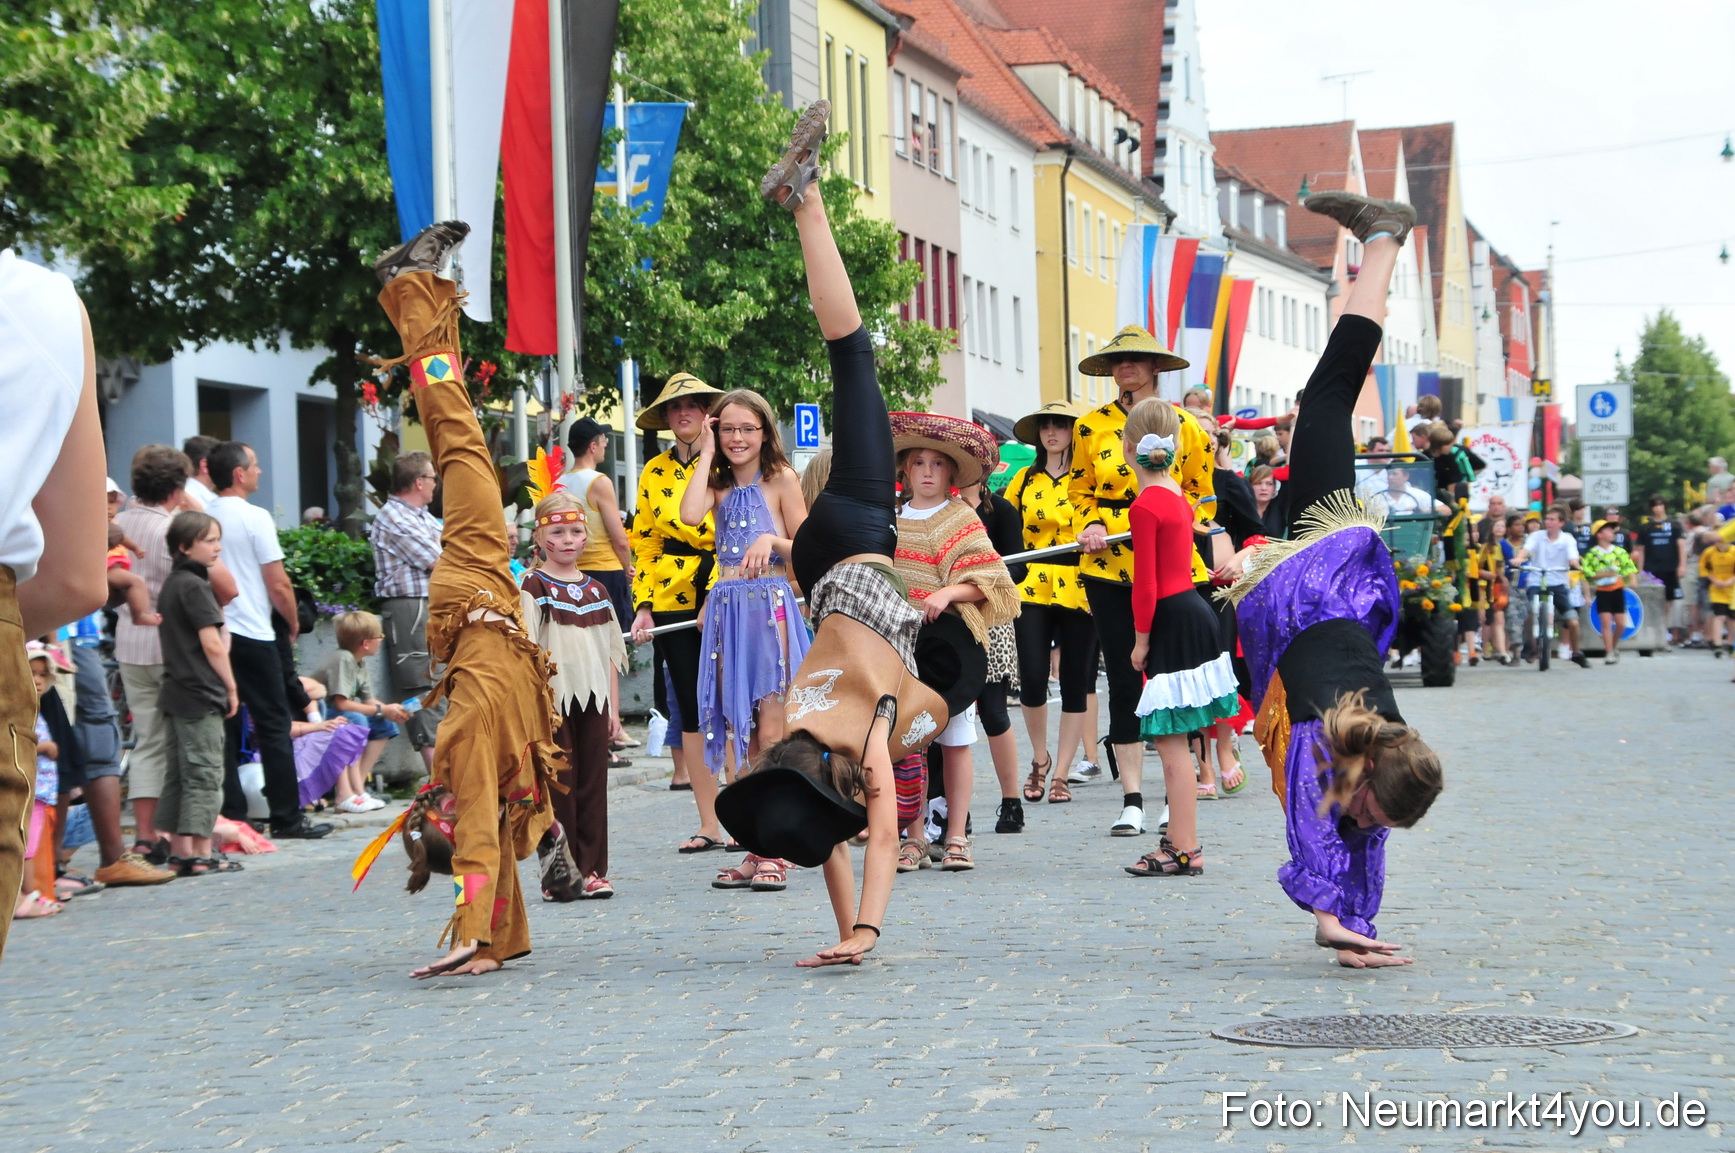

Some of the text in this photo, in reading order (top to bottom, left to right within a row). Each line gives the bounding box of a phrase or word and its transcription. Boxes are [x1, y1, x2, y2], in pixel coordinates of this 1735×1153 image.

[1533, 381, 1550, 395] H
[800, 409, 814, 442] P
[1590, 423, 1618, 432] ZONE
